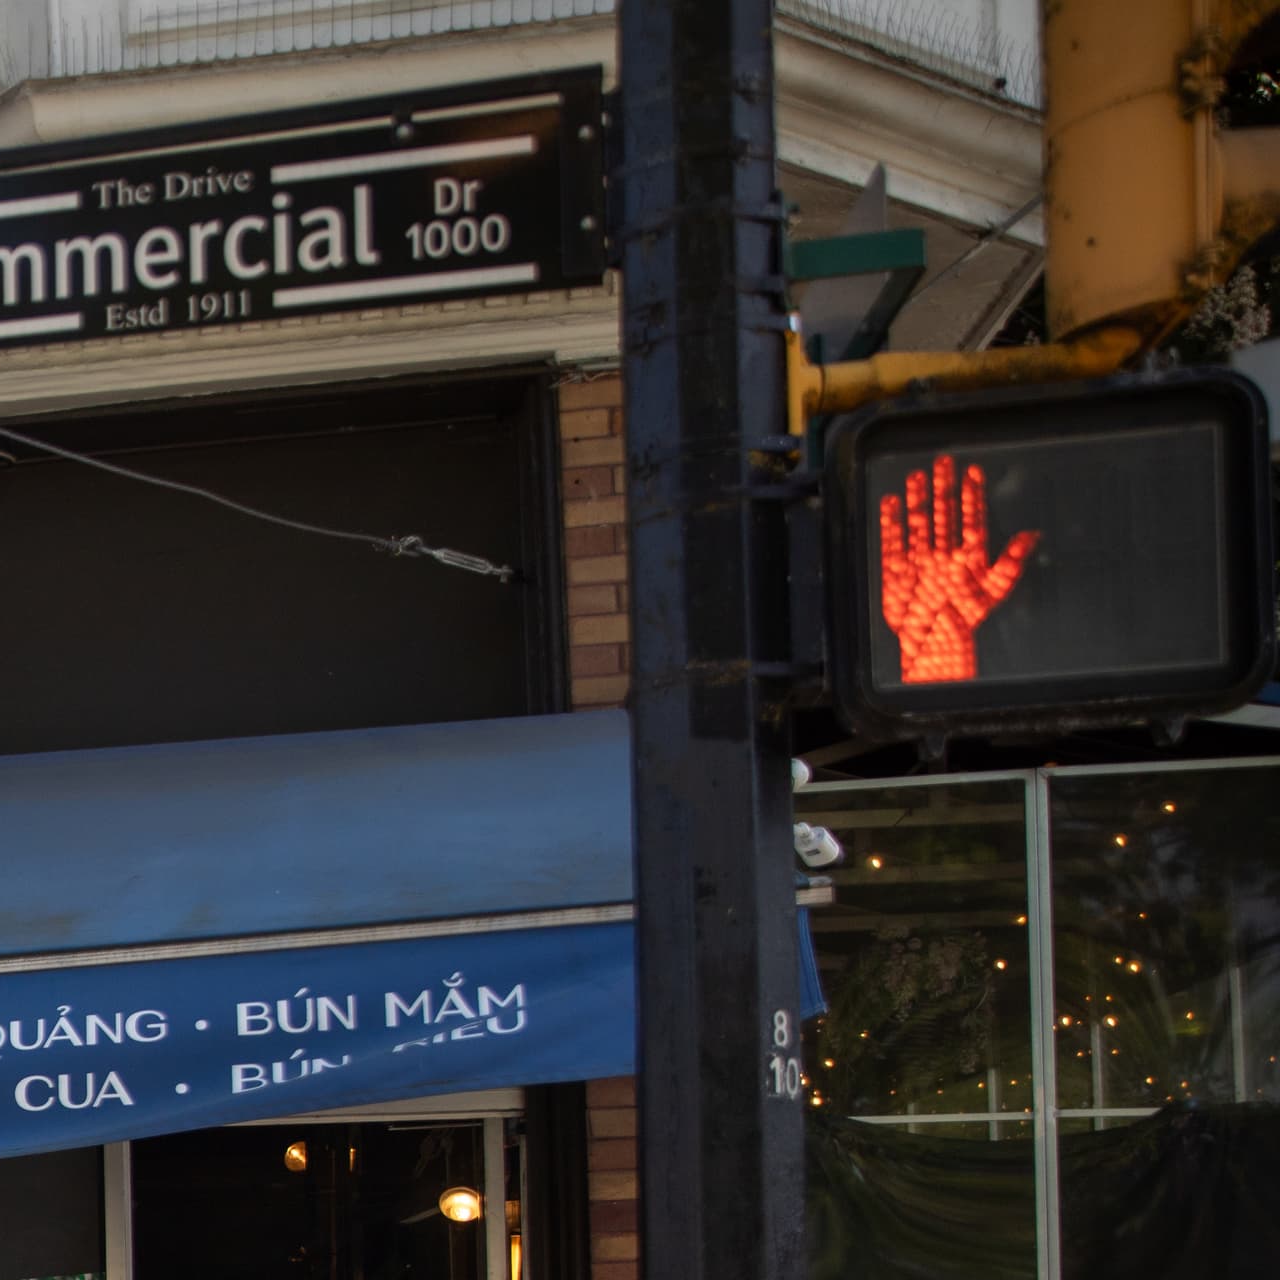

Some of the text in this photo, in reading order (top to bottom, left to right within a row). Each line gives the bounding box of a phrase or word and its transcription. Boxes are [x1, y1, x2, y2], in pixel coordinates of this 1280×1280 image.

[91, 168, 254, 209] The Drive
[433, 177, 480, 217] Dr
[404, 215, 510, 262] 1000
[103, 291, 253, 332] Estd 1911
[236, 986, 359, 1037] BÚN
[773, 1008, 789, 1047] 8
[14, 1069, 136, 1111] CUA
[769, 1056, 799, 1097] 10
